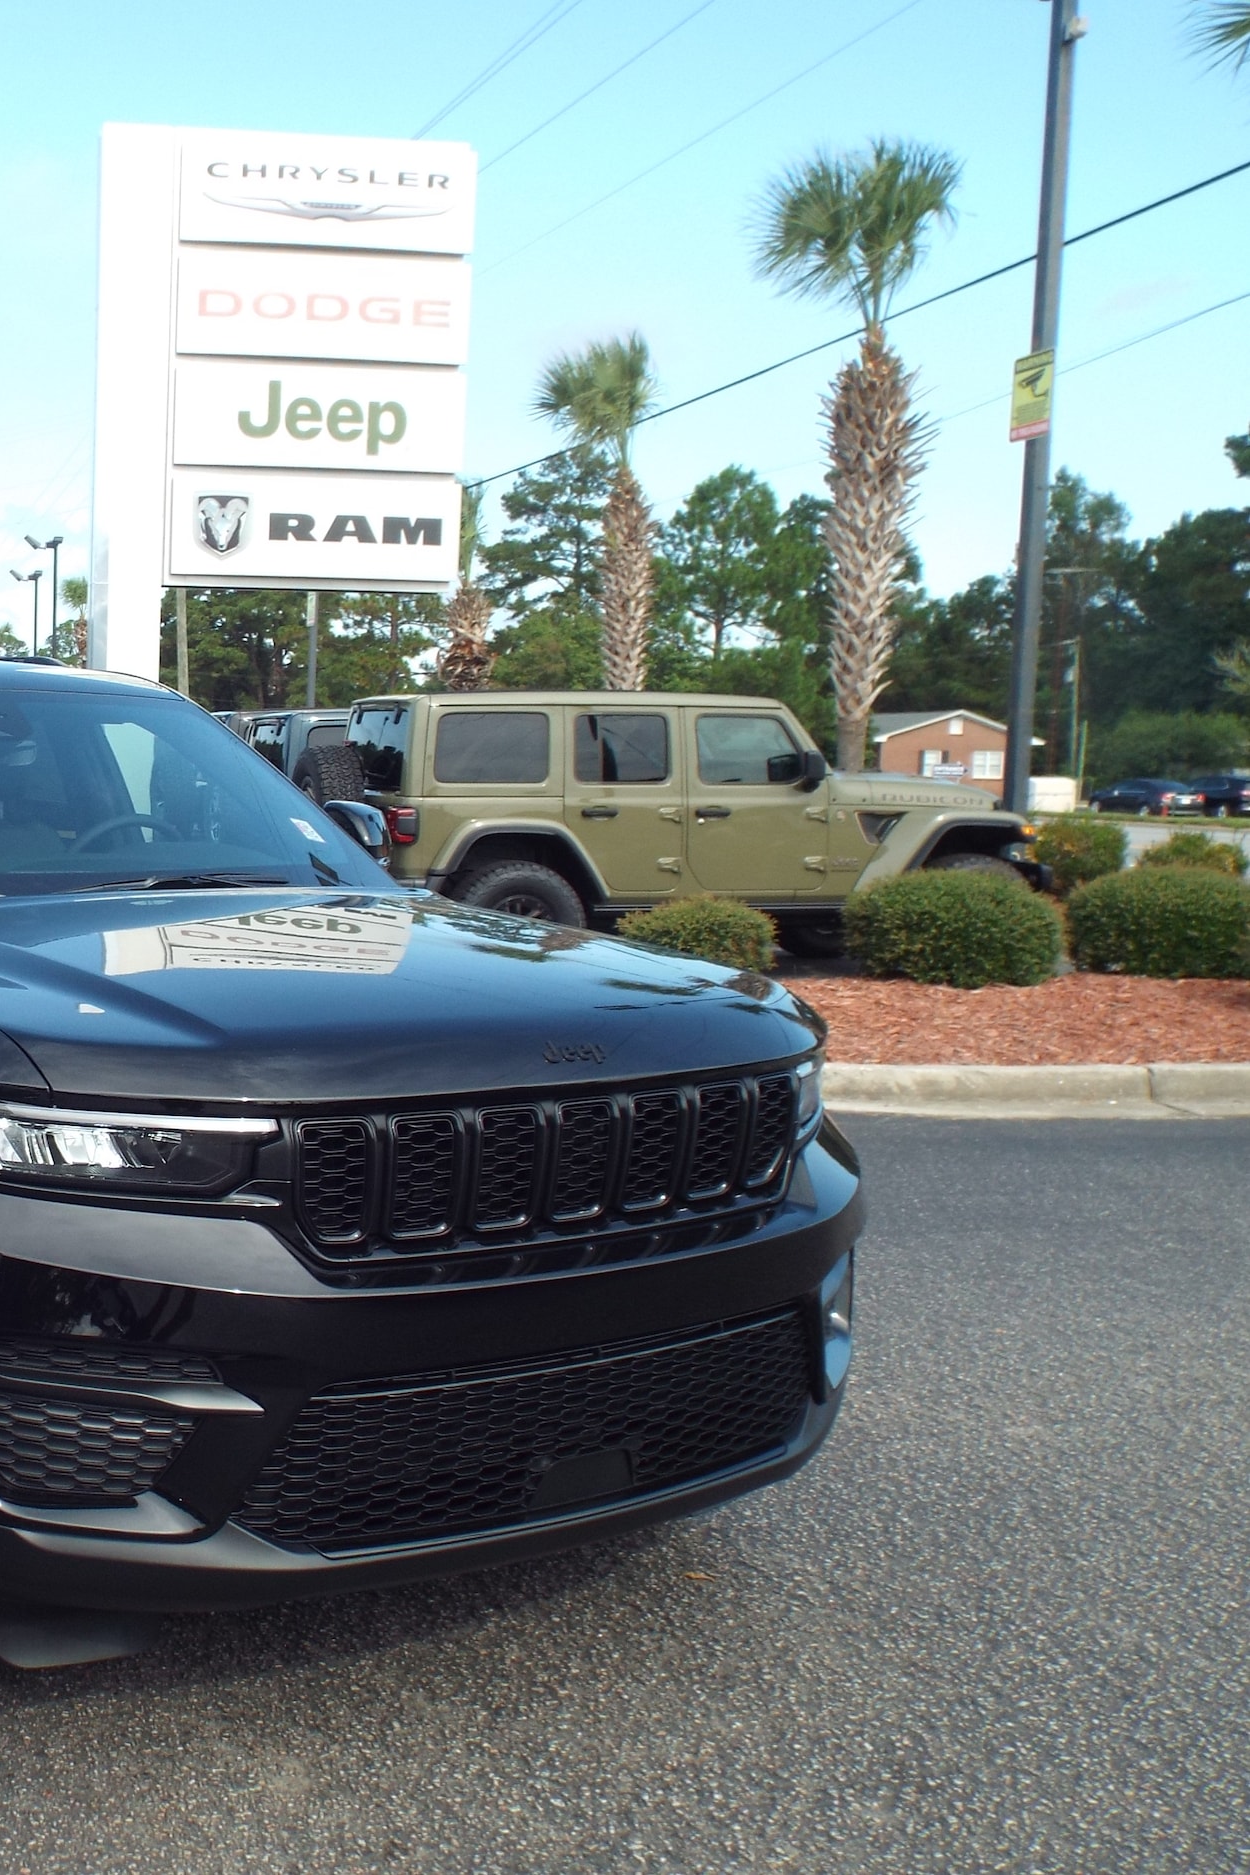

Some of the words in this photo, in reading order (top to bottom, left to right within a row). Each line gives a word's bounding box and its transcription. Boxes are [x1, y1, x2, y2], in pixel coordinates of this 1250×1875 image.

[207, 161, 450, 191] CHRYSLER
[197, 289, 451, 328] DODGE
[237, 380, 408, 456] Jeep
[268, 512, 443, 546] RAM
[881, 793, 983, 806] RUBICON
[541, 1039, 607, 1065] Jeep
